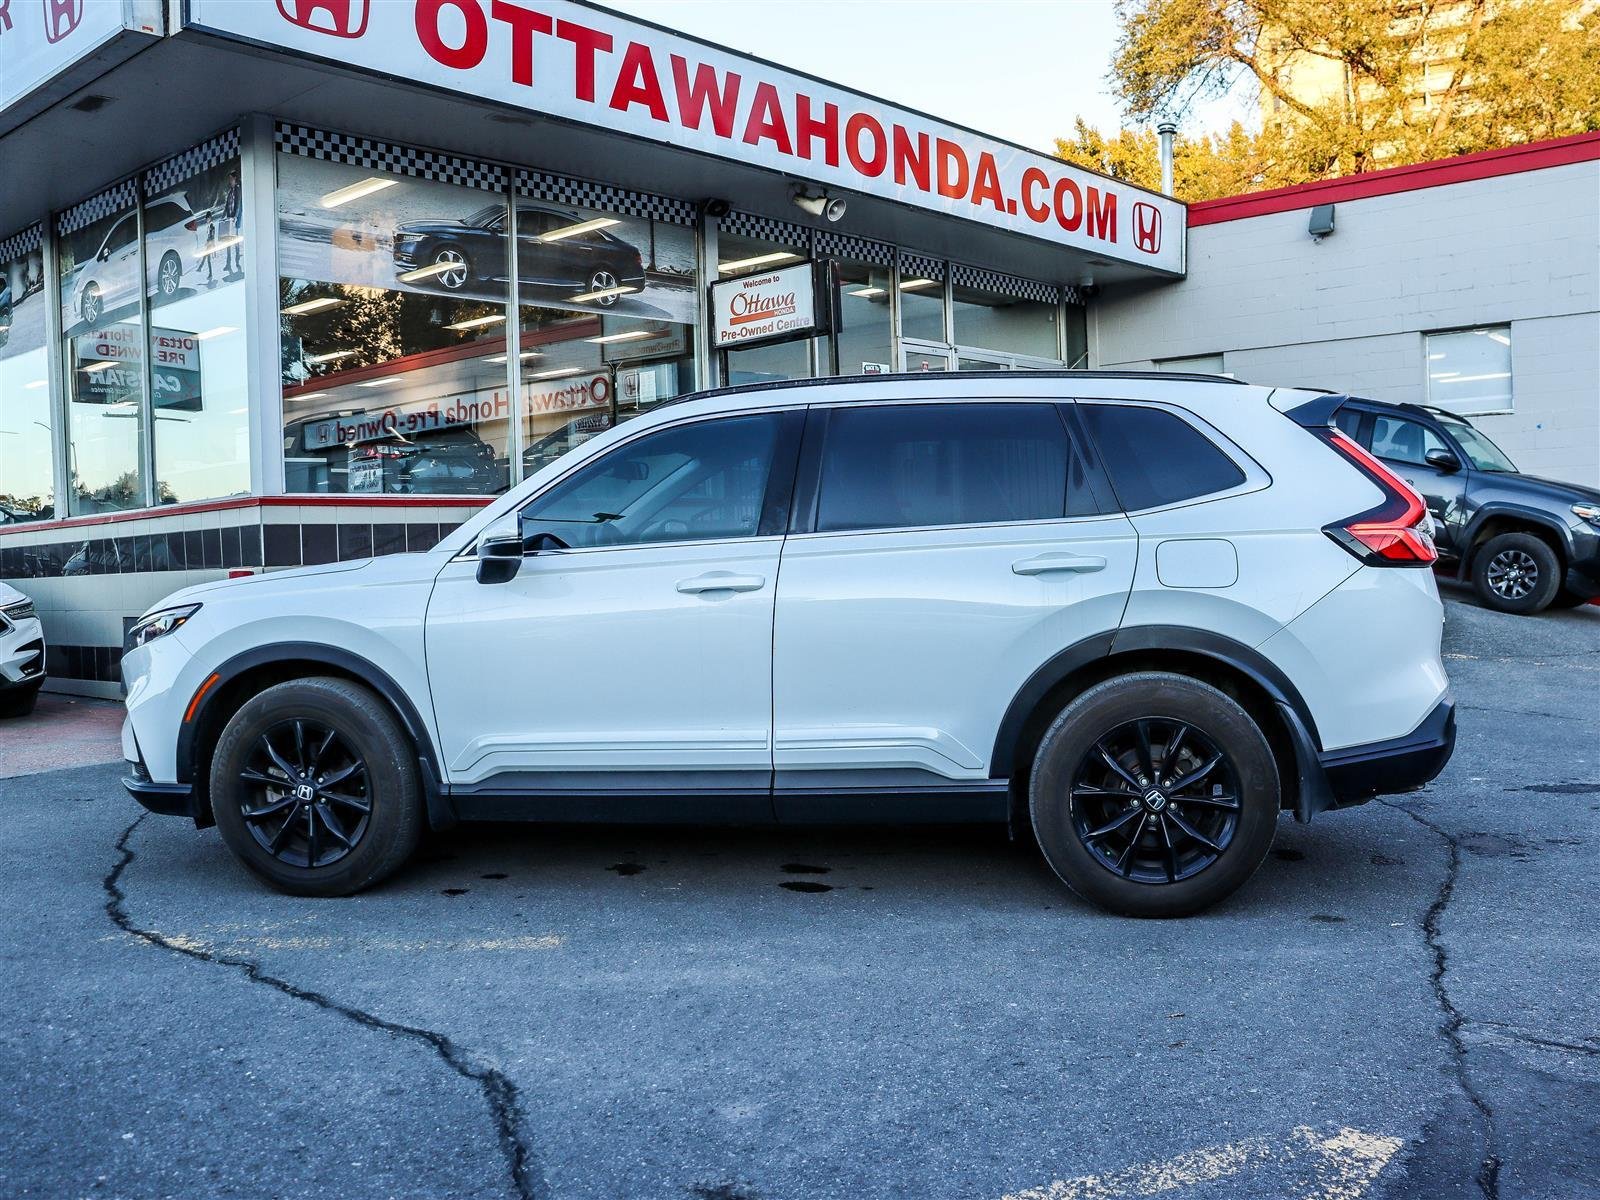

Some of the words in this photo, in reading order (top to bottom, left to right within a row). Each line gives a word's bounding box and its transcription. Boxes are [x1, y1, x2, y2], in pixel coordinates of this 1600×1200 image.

[415, 0, 1117, 243] OTTAWAHONDA.COM
[743, 278, 772, 289] Welcome
[773, 275, 780, 283] to
[730, 292, 796, 317] Ottawa
[721, 322, 774, 341] Pre-Owned
[777, 317, 810, 331] Centre
